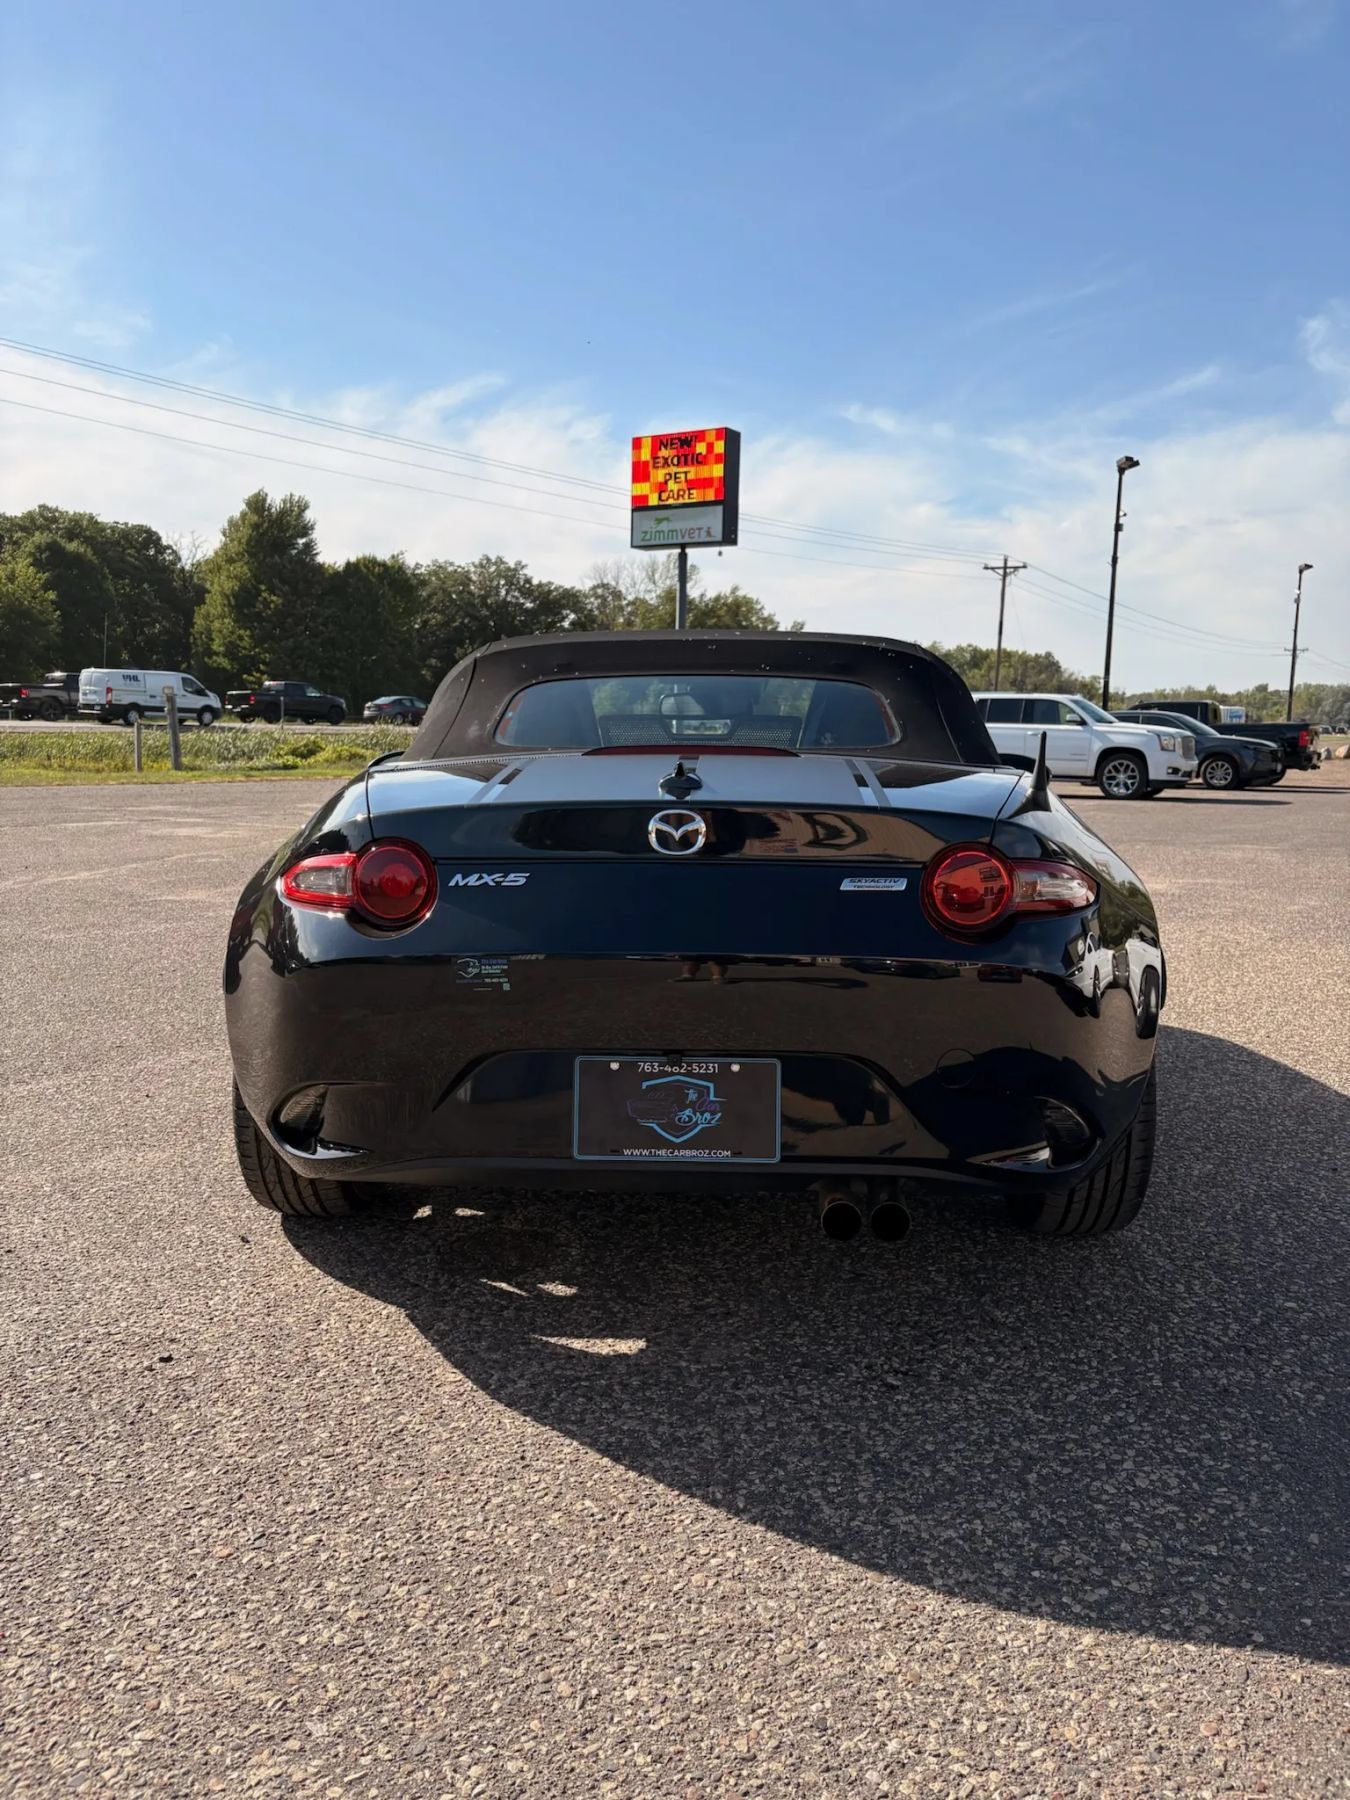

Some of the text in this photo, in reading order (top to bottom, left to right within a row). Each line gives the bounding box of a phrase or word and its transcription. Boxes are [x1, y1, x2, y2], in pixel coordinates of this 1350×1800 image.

[652, 452, 704, 469] EXOTIC
[664, 470, 691, 484] PET
[658, 488, 695, 502] CARE
[448, 872, 530, 887] MX-5
[623, 1148, 731, 1158] WWW.THECARBROZ.COM
